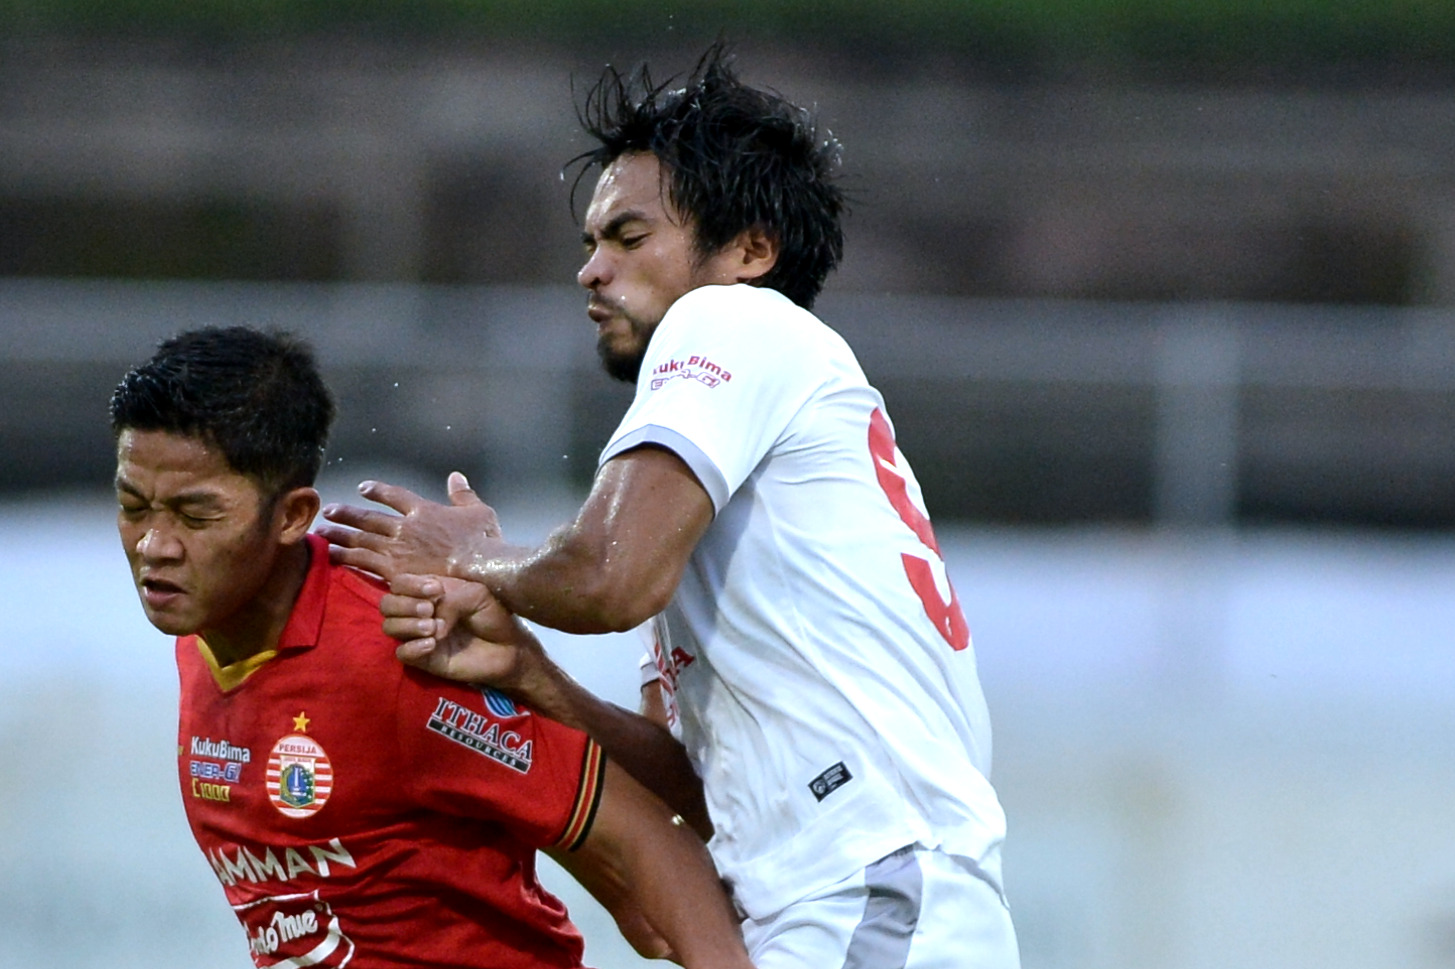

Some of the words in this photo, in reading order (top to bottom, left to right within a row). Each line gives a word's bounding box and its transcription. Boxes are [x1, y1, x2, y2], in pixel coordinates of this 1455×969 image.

[431, 697, 532, 763] ITHACA
[191, 736, 251, 763] KukuBima
[279, 744, 317, 754] PERSIJA
[441, 725, 516, 767] RESOURCES
[192, 778, 231, 802] C1000
